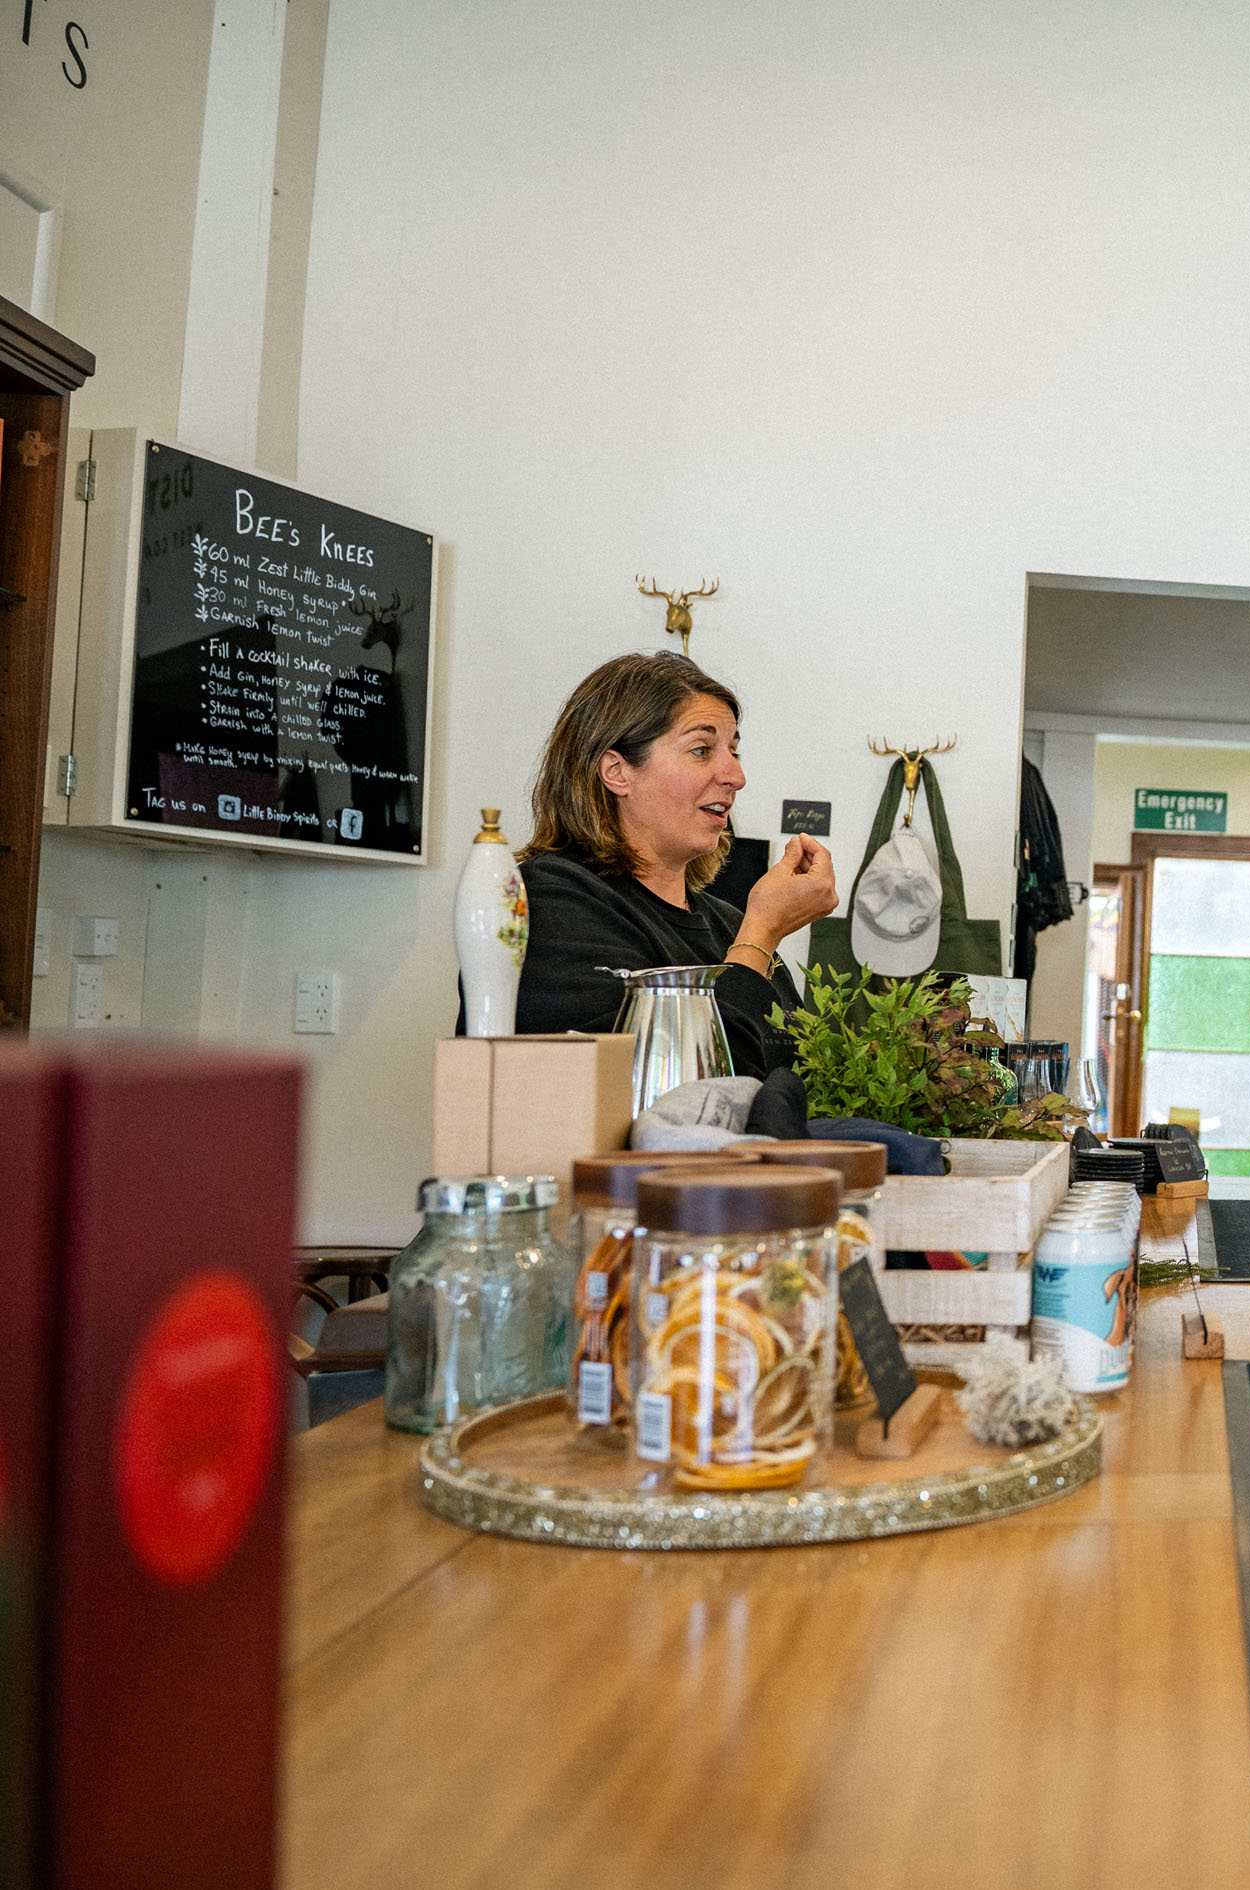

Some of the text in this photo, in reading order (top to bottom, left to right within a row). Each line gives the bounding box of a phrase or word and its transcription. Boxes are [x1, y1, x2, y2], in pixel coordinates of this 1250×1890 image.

[207, 542, 230, 562] 60
[233, 553, 251, 570] ml
[325, 573, 355, 602] Biddy
[359, 583, 377, 602] Gin
[209, 566, 228, 584] 45
[233, 574, 249, 590] ml
[208, 586, 227, 604] 30
[232, 595, 247, 609] ml
[307, 630, 335, 647] twist
[209, 638, 229, 659] Fill
[338, 665, 360, 681] with
[209, 662, 231, 681] Add
[171, 799, 187, 812] us
[192, 803, 207, 814] on
[1137, 790, 1224, 830] Emergency Exit
